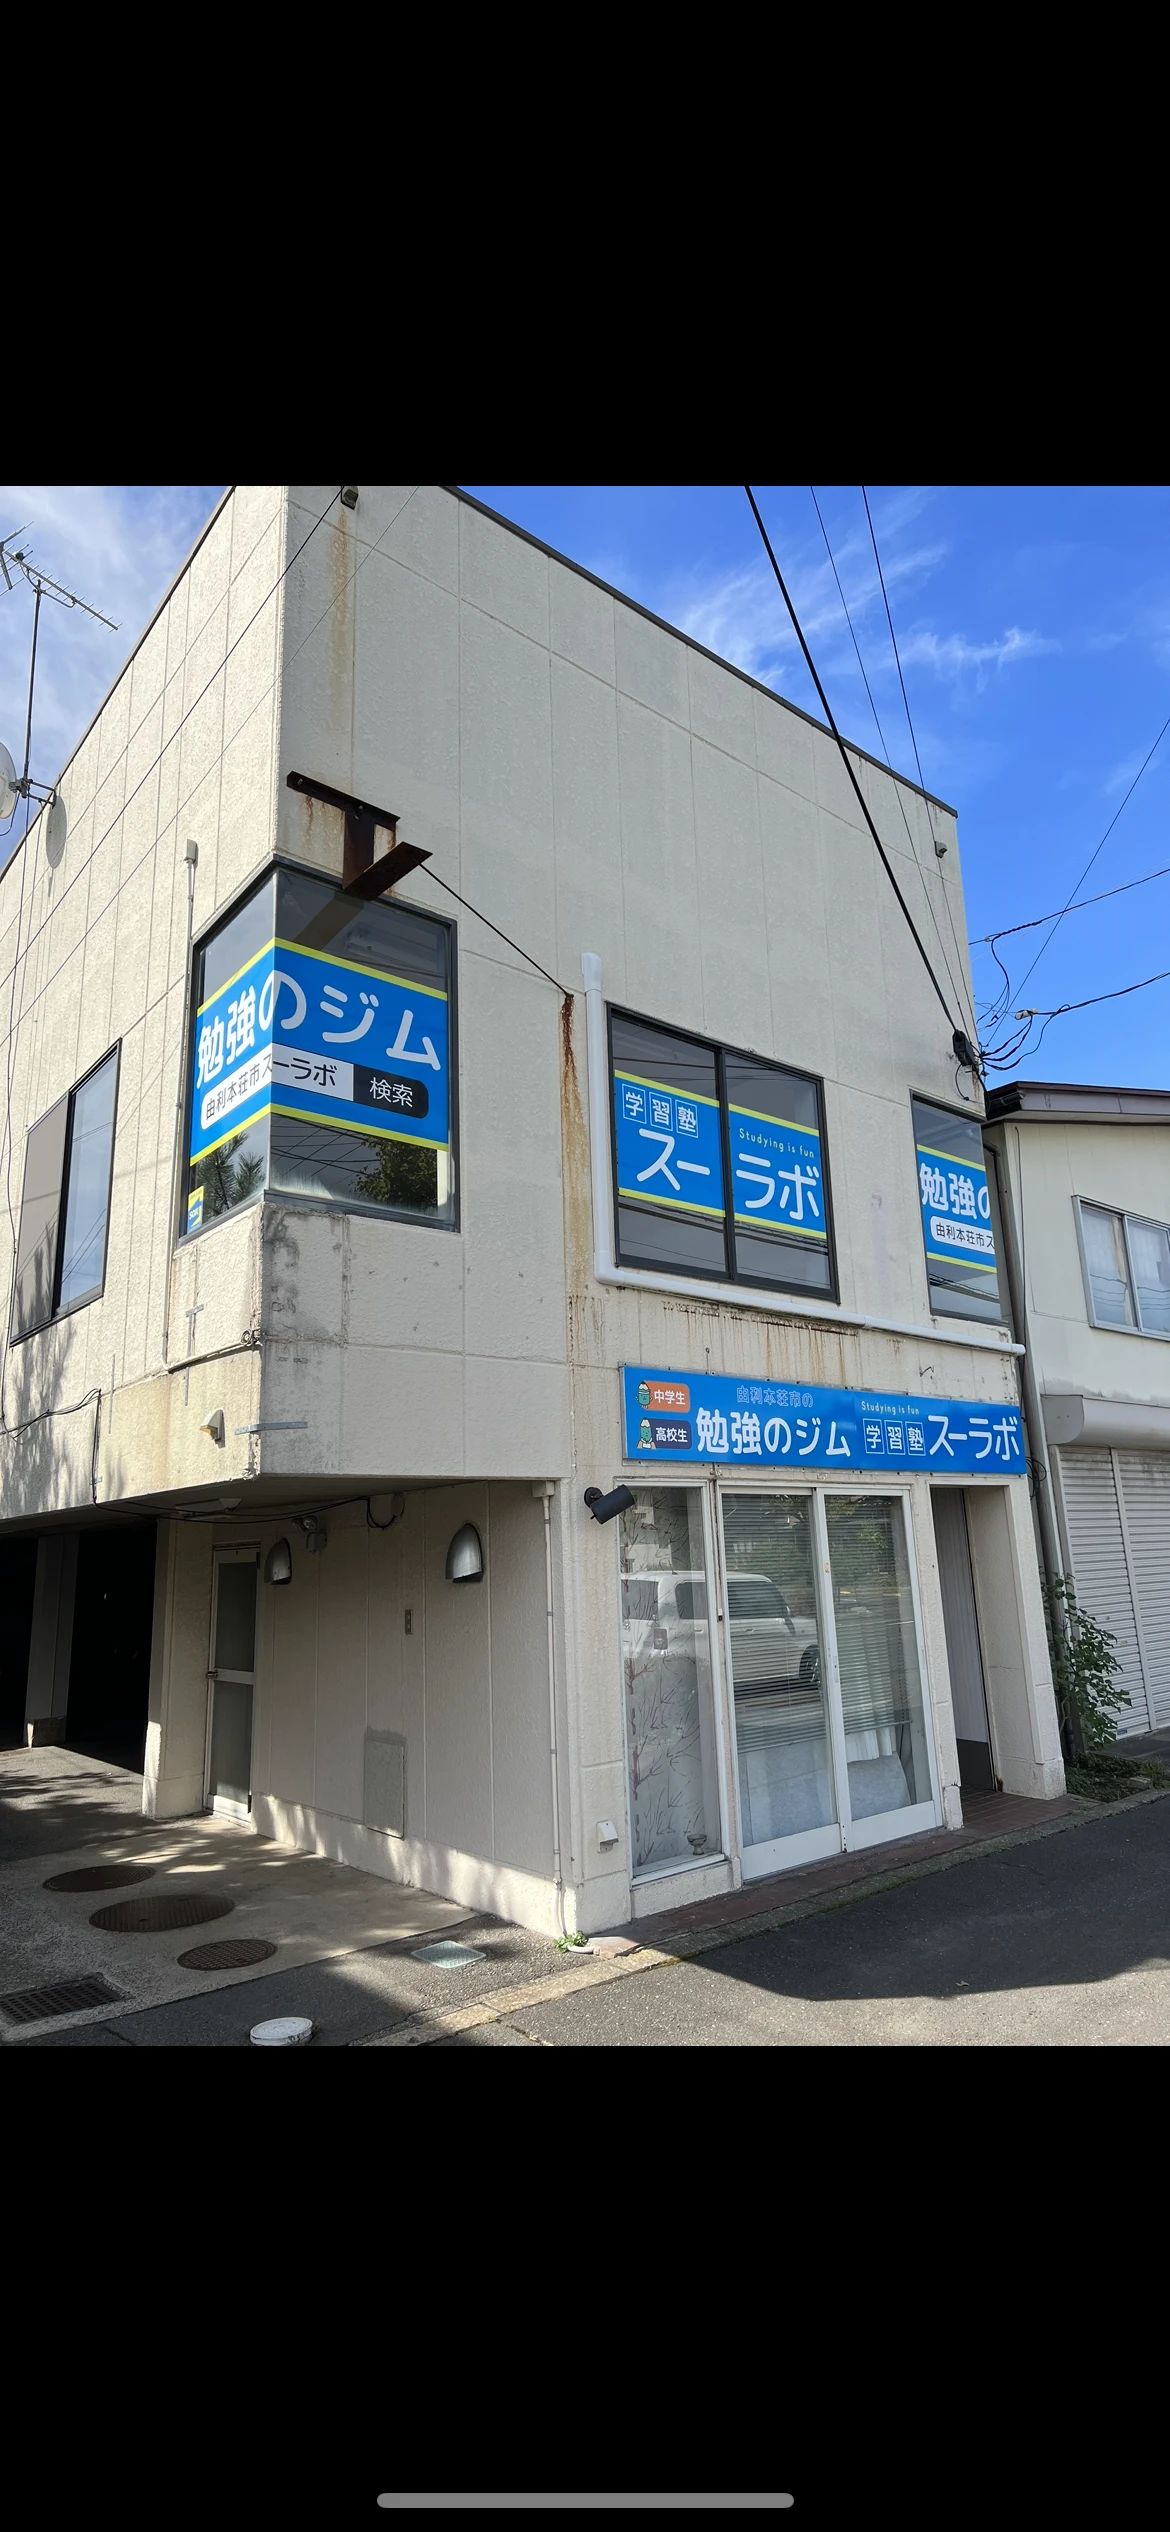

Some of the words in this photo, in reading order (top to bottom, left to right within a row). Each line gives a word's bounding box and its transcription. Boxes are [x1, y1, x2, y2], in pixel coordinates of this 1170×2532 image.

[196, 970, 442, 1089] 勉強のジム
[369, 1076, 413, 1108] 検索
[626, 1091, 696, 1133] 学習塾
[739, 1127, 784, 1153] Studying
[787, 1142, 796, 1154] is
[799, 1145, 815, 1159] fun
[654, 1389, 686, 1406] 中学生
[736, 1384, 814, 1408] 由利本荘市の
[861, 1401, 896, 1416] Studying
[898, 1407, 905, 1415] is
[907, 1407, 920, 1416] fun
[655, 1427, 688, 1443] 高校生
[695, 1407, 851, 1457] 勉強のジム
[865, 1424, 924, 1452] 学習塾
[928, 1414, 1020, 1461] スーラボ
